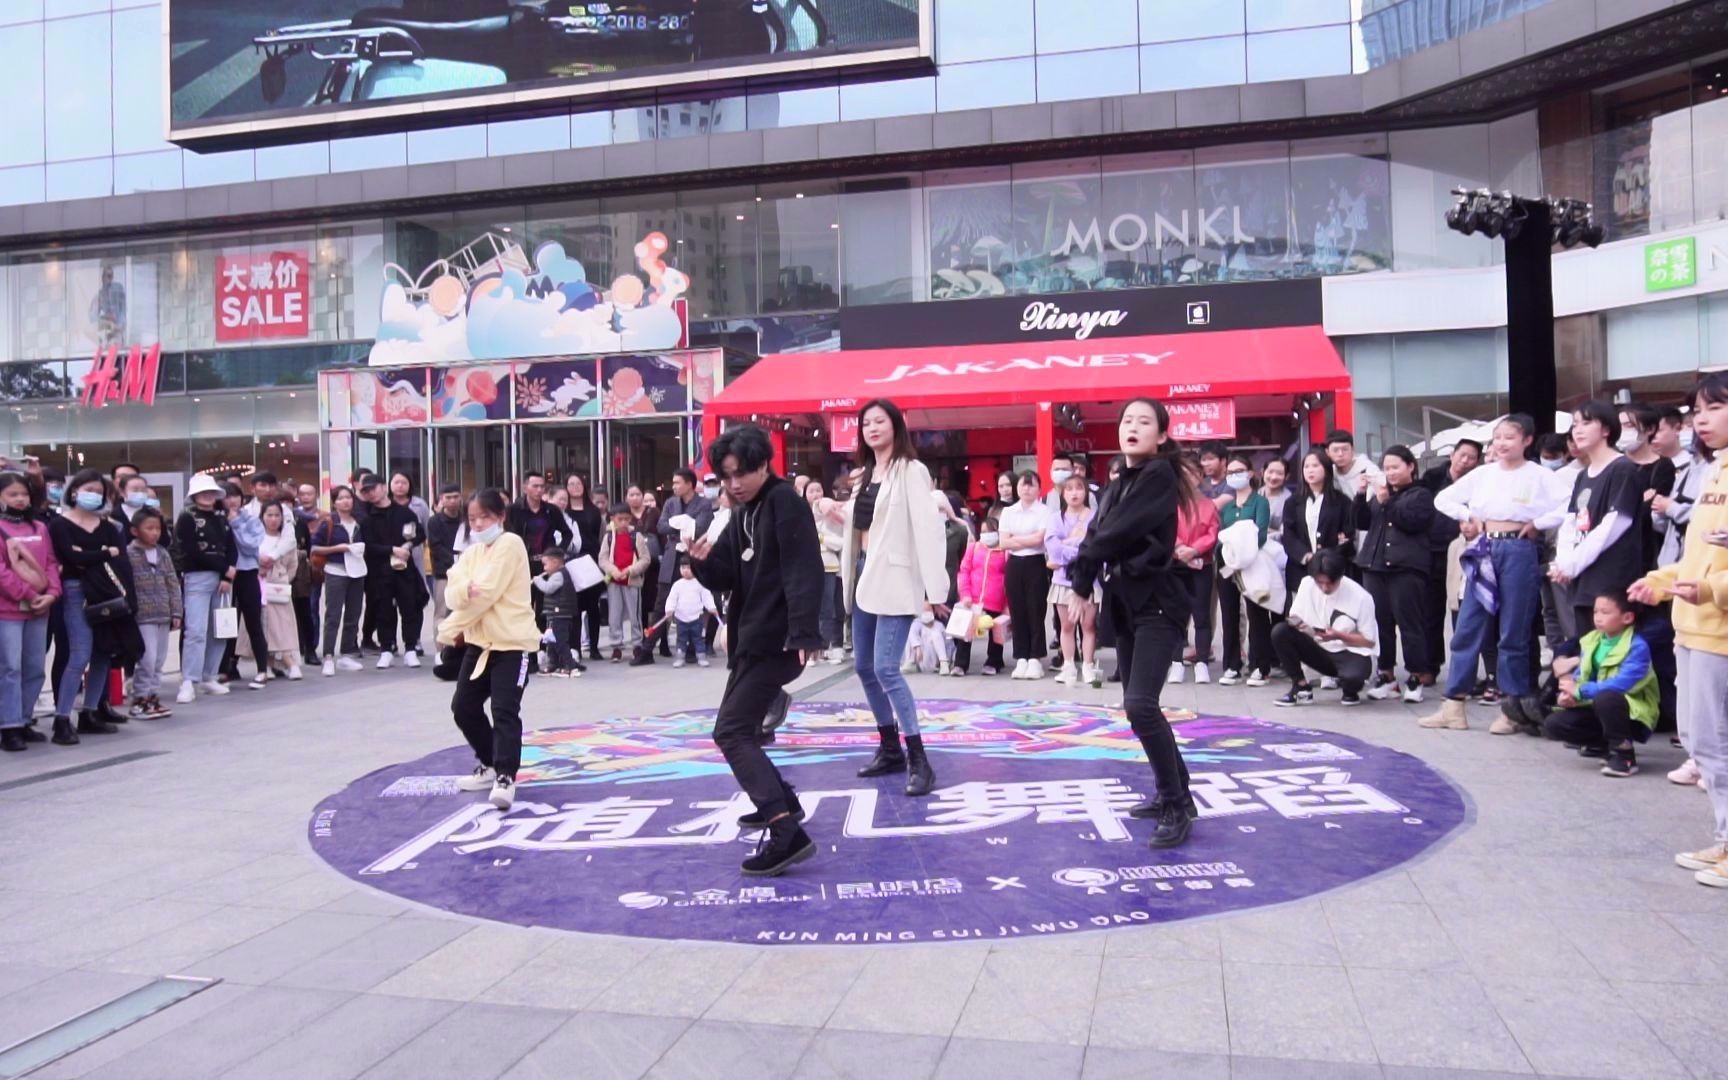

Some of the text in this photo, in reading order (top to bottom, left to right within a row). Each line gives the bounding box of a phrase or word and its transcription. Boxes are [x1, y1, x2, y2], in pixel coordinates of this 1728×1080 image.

[222, 259, 300, 292] 大减价
[222, 292, 303, 328] SALE
[1020, 301, 1127, 340] Xinya
[80, 342, 161, 408] H&M
[863, 351, 1176, 384] JAKANEY
[821, 398, 857, 411] JAKANEY
[1168, 384, 1211, 397] JAKANEY
[1025, 437, 1096, 454] JAANEY
[757, 910, 1151, 942] KUN MING SUI JI WU DAO
